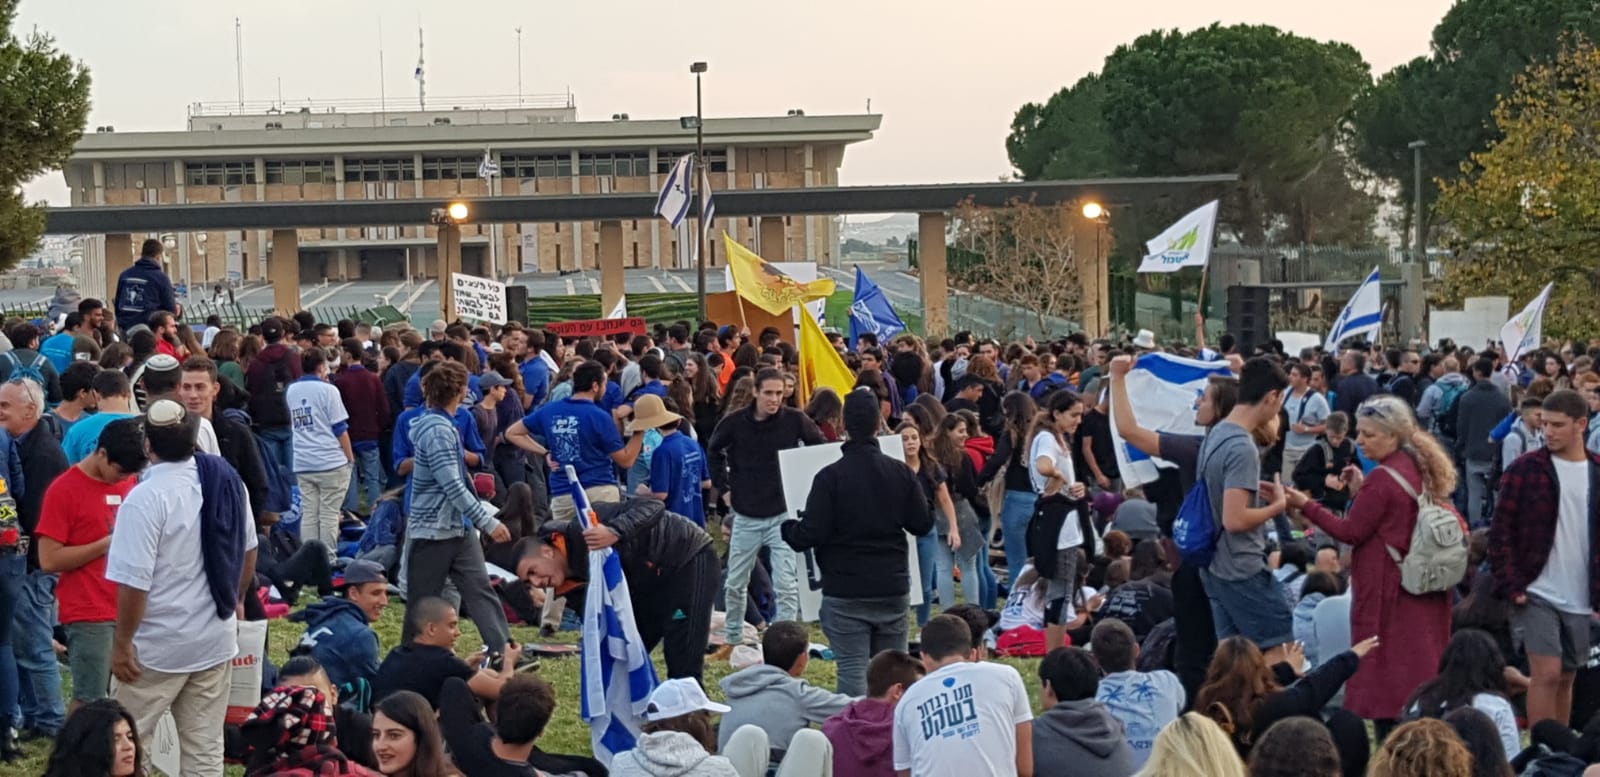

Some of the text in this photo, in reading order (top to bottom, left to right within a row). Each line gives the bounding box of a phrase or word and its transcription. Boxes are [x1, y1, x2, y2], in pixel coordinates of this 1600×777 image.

[916, 684, 973, 719] תנו לגדול
[921, 698, 977, 741] בשקט
